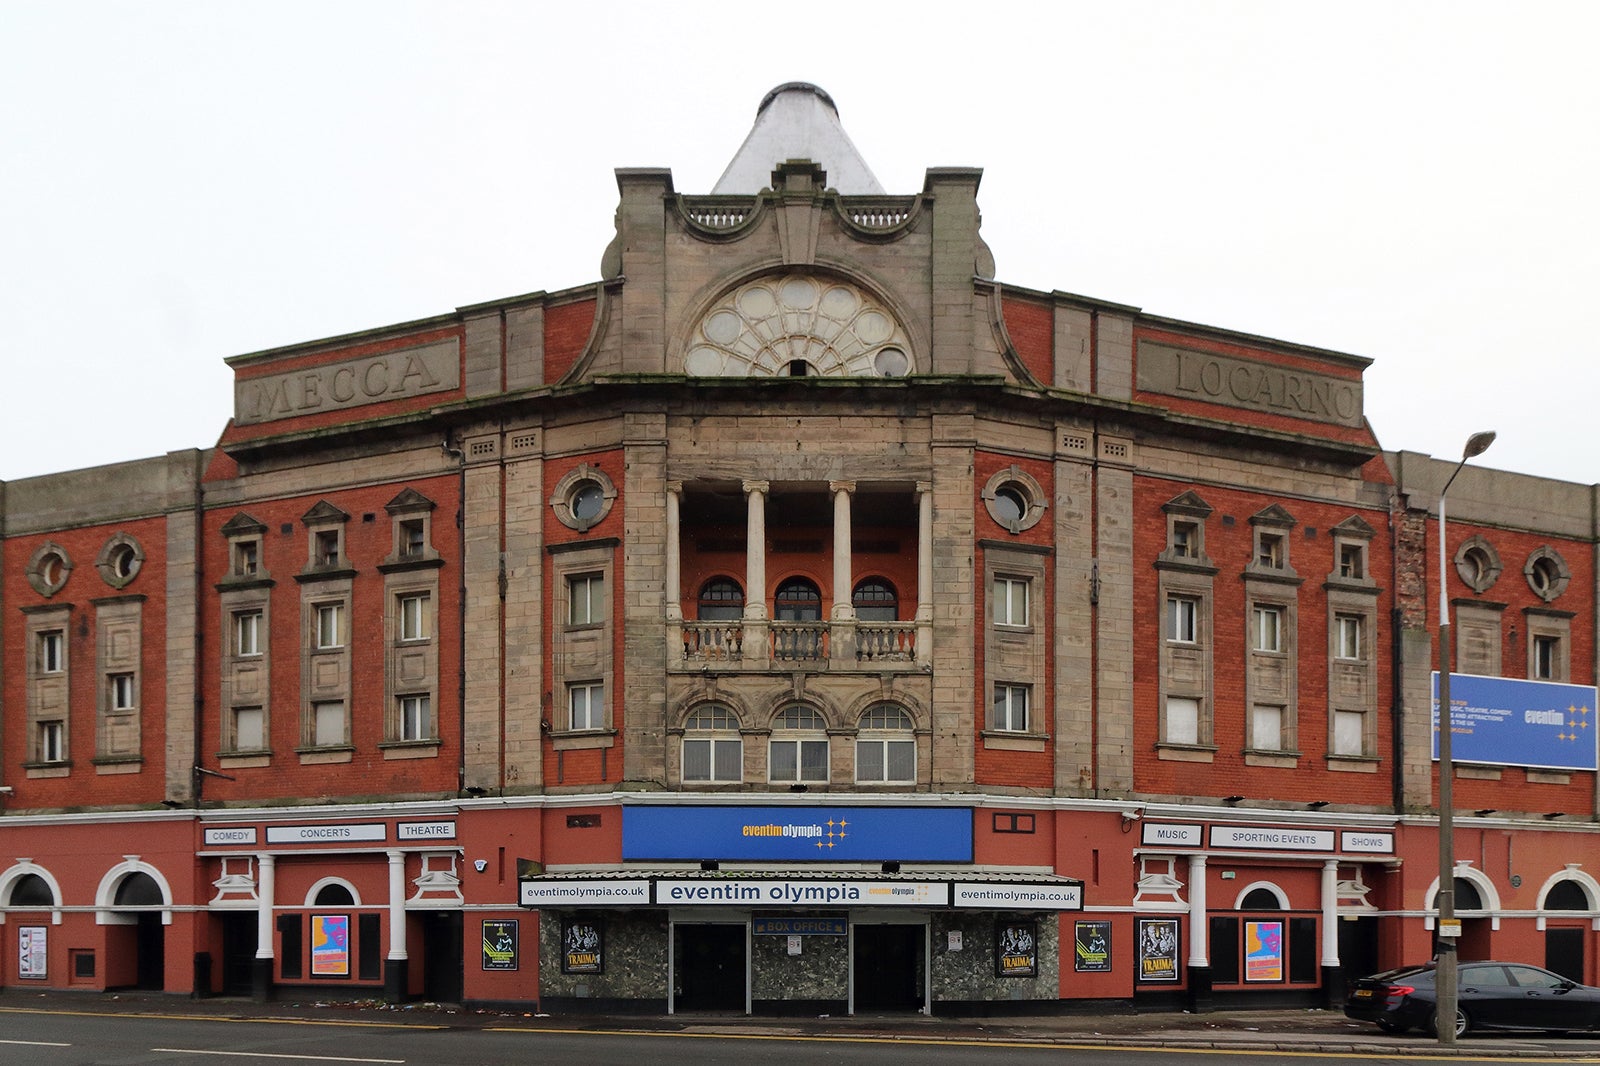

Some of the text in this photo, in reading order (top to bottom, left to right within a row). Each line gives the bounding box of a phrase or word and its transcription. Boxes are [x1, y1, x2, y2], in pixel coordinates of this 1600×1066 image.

[250, 352, 441, 418] MECCA
[1175, 354, 1354, 420] LOCARNO
[1525, 710, 1564, 726] eventim
[212, 831, 250, 841] COMEDY
[300, 828, 351, 838] CONCERTS
[405, 825, 449, 836] THEATRE
[1157, 829, 1188, 840] MUSIC
[1232, 832, 1317, 845] SPORTING EVENTS
[1351, 837, 1383, 847] SHOWS
[527, 886, 644, 898] eventimolympia.co.uk
[670, 883, 860, 903] eventim olympia
[961, 890, 1075, 902] eventimolympia.co.uk
[767, 922, 832, 932] BOX OFFICE
[568, 953, 597, 965] TRAUMA
[1002, 956, 1031, 968] TRAUMA
[1143, 958, 1173, 971] TRAUMA
